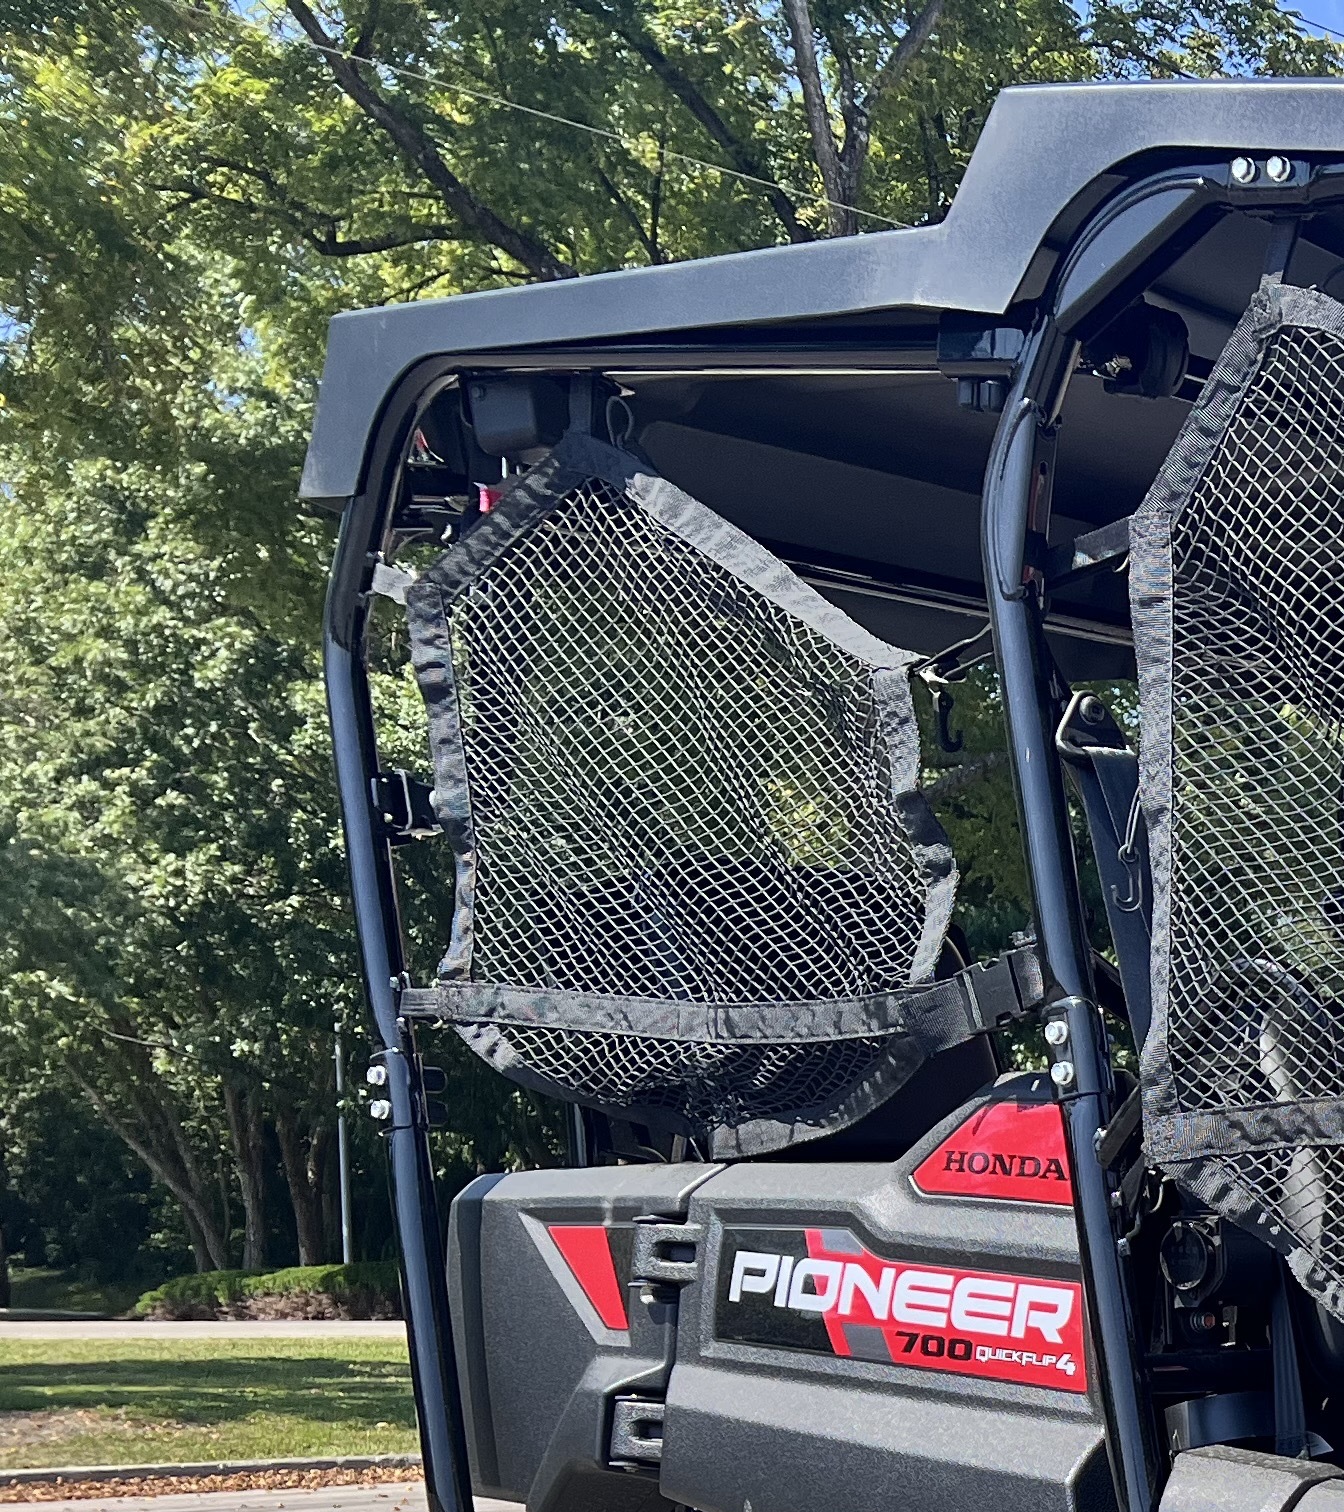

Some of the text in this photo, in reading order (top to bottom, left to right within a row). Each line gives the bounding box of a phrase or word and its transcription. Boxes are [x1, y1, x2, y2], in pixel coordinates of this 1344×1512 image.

[943, 1149, 1069, 1181] HONDA
[728, 1250, 1074, 1344] PIONEER
[895, 1330, 973, 1361] 700
